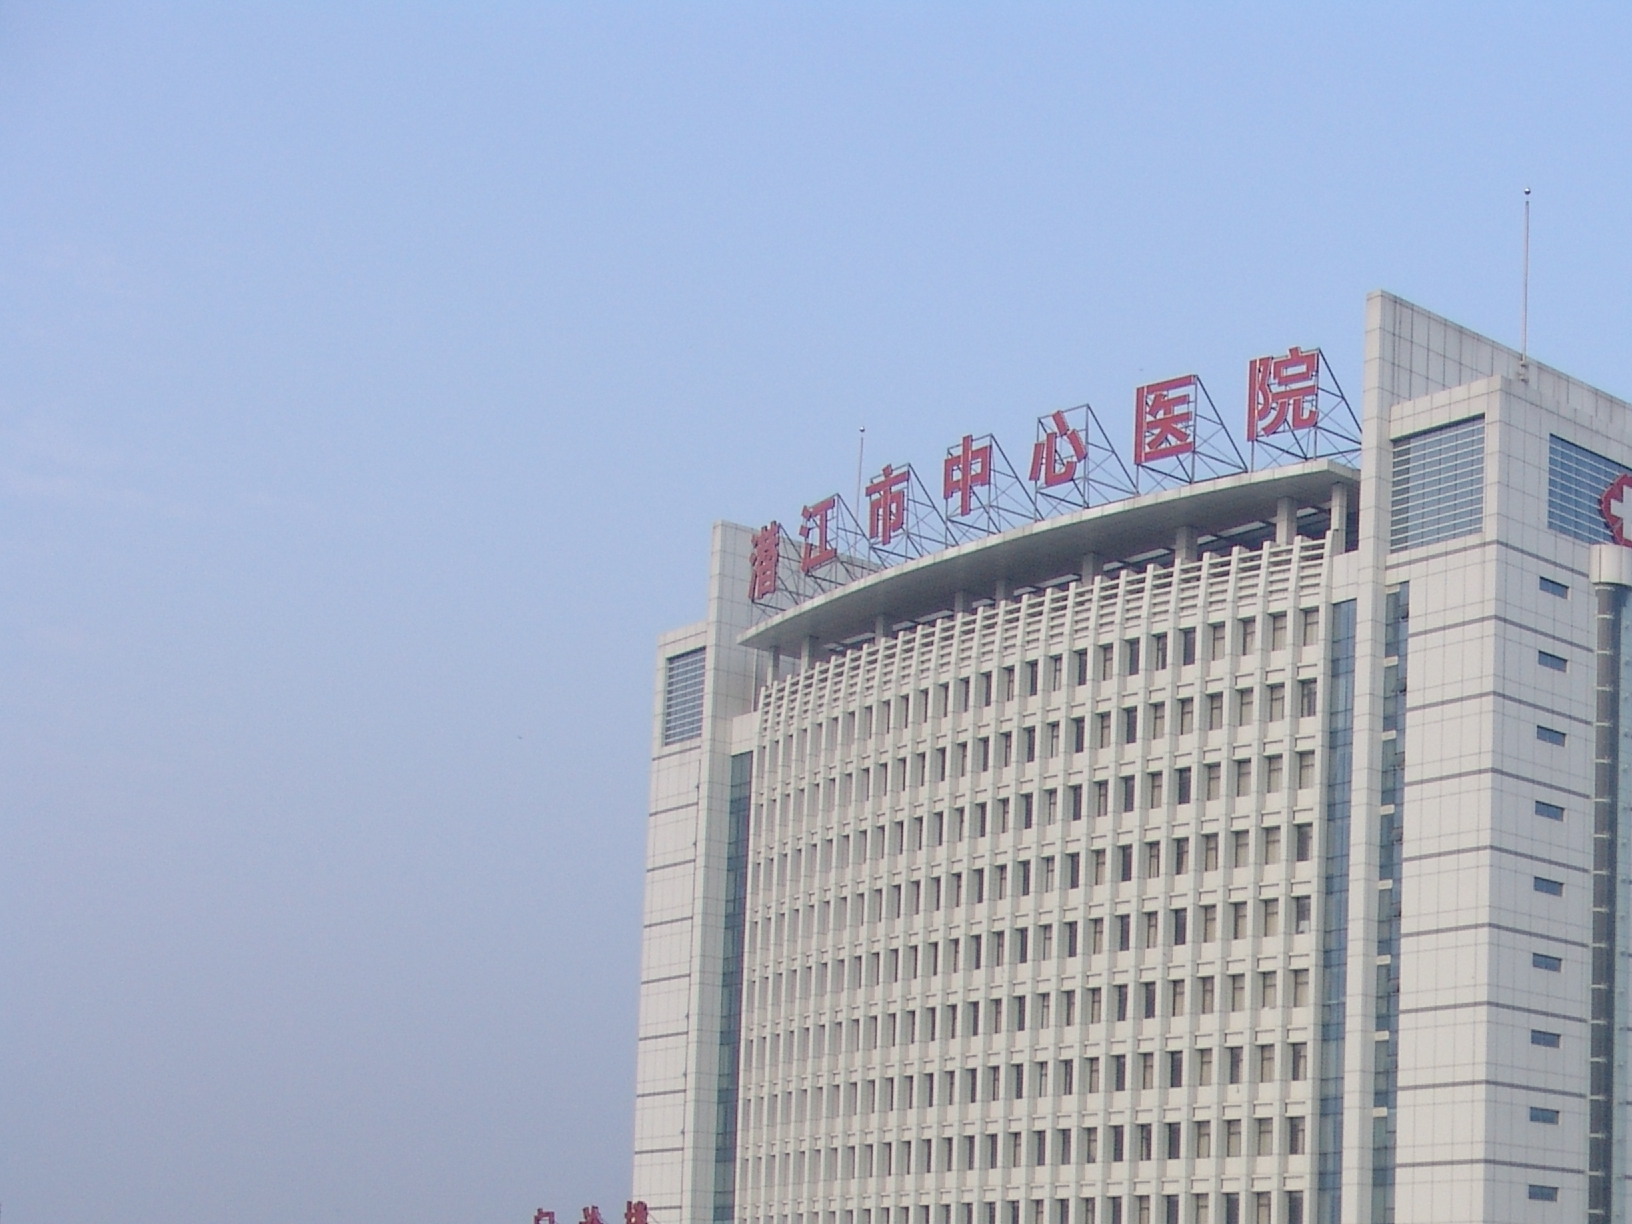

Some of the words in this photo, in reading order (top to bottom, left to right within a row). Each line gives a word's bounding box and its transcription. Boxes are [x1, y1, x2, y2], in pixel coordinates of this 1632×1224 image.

[750, 347, 1319, 600] 潜江市中心医院
